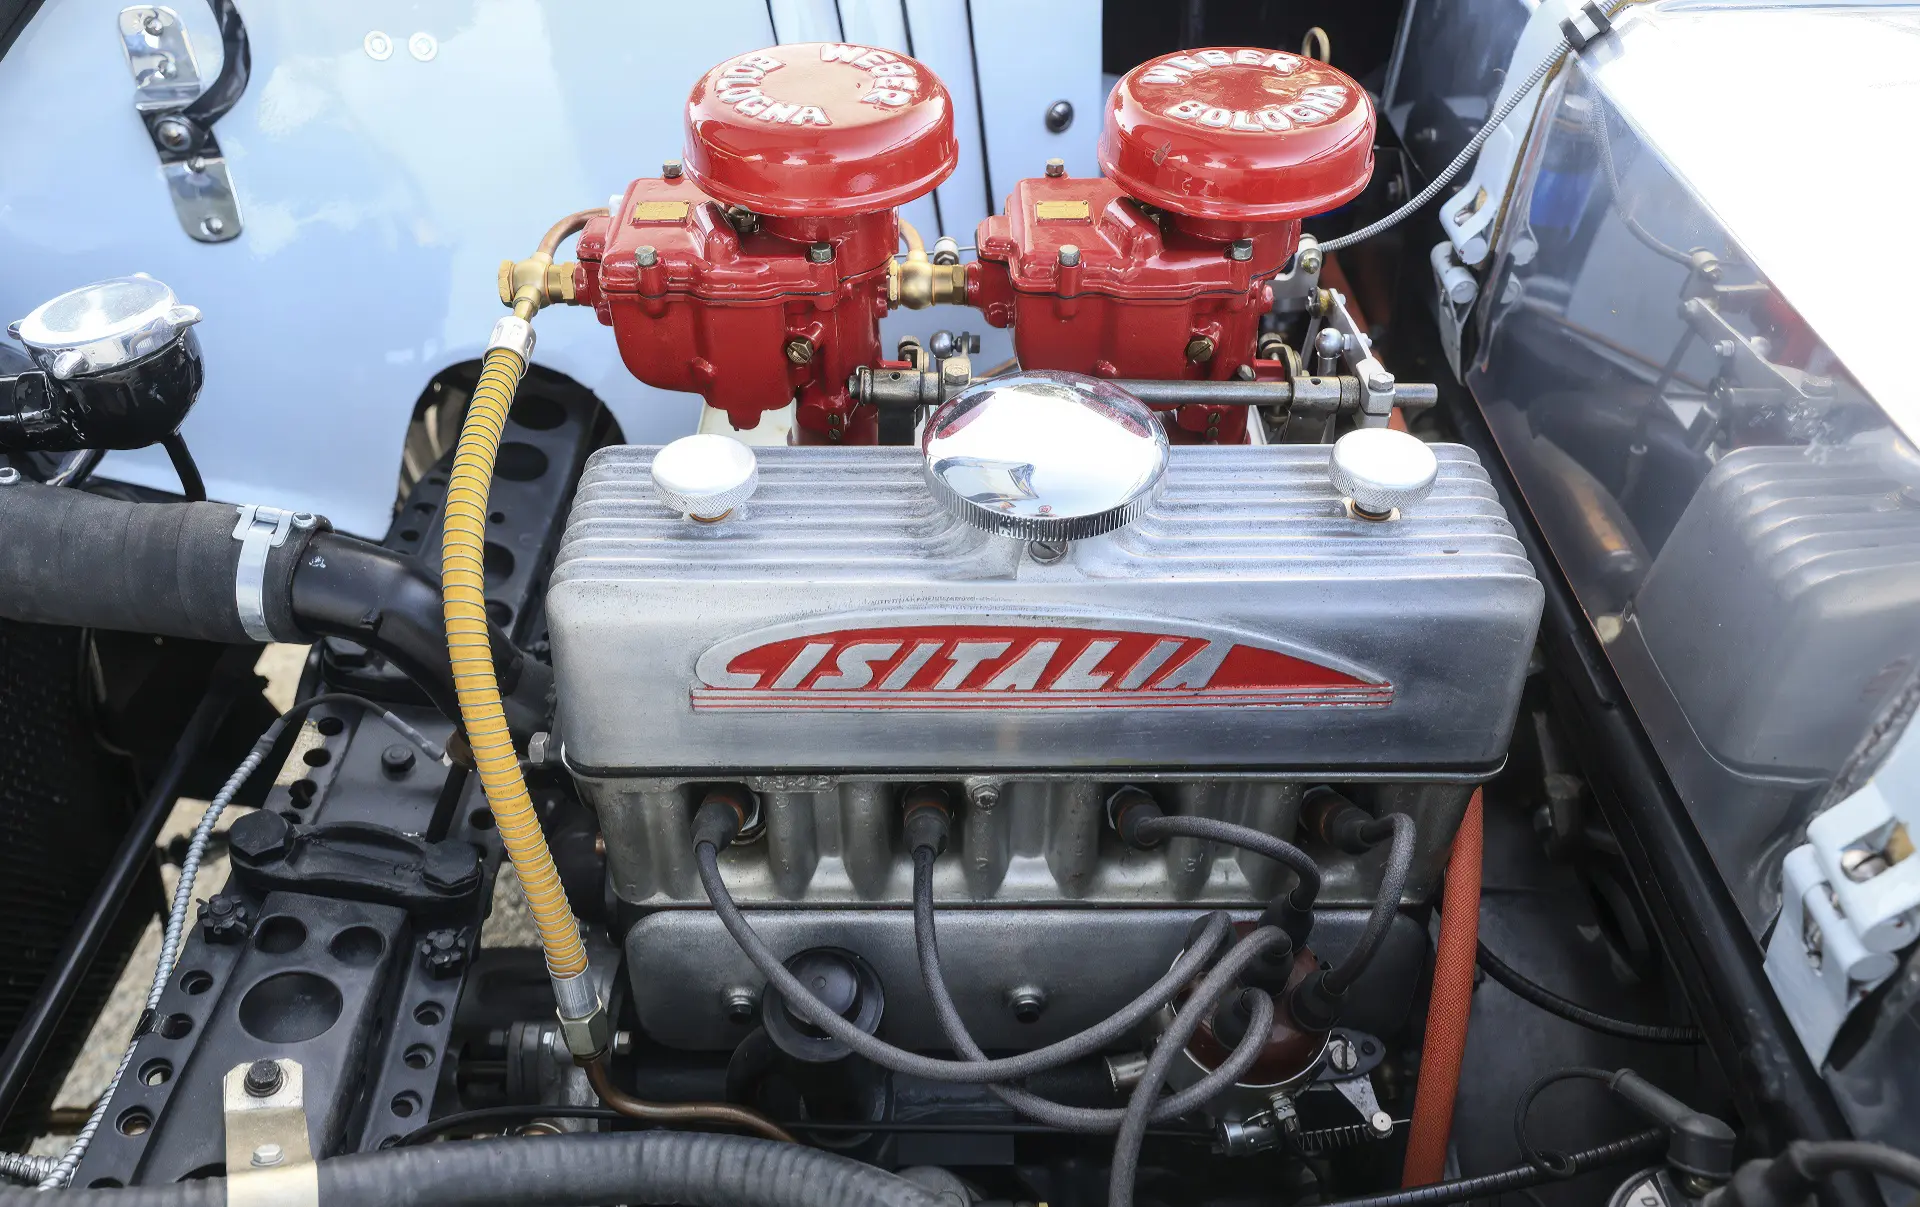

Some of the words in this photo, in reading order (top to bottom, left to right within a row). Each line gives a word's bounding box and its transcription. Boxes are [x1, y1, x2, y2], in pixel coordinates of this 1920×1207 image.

[714, 55, 832, 126] BOLOGNA
[819, 43, 919, 107] WEBER
[1139, 50, 1303, 87] WEBER
[1163, 85, 1348, 132] BOLOGNA
[695, 624, 1240, 691] CISITALIA
